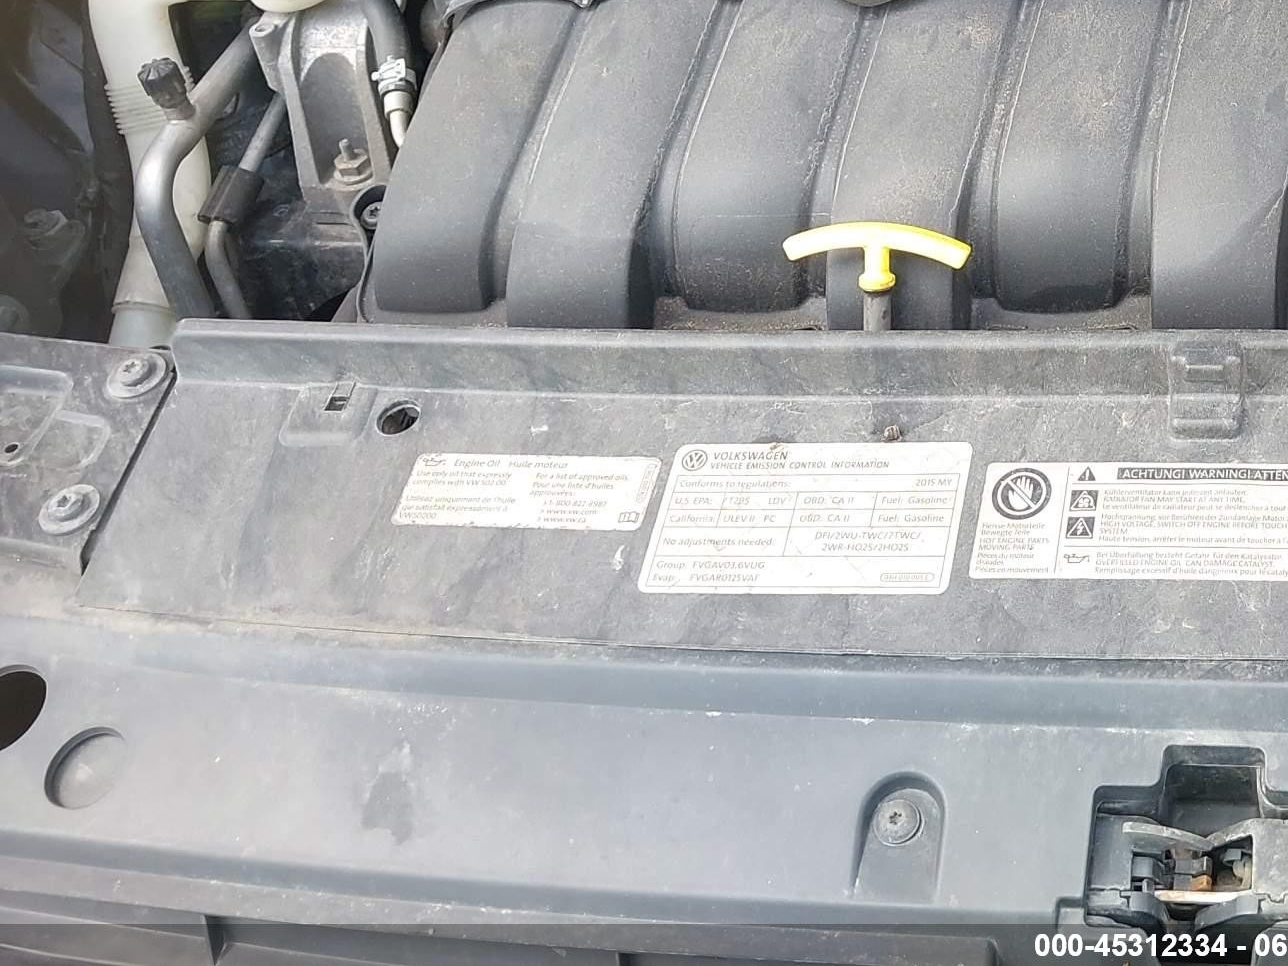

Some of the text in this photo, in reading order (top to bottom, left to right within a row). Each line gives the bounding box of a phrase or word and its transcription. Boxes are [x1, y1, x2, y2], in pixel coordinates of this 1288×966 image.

[713, 451, 789, 461] VOLKSWAGEN
[454, 458, 569, 470] Engine Oil Huile moteur
[710, 460, 890, 470] VEHICLE EMISSION CONTROL INFORMATION
[578, 474, 613, 483] approved
[1121, 468, 1185, 479] ACHTUNG!
[1189, 468, 1251, 480] WARNING!
[680, 480, 722, 488] Conforms
[915, 479, 936, 487] 2015
[908, 496, 948, 505] Gasoline
[904, 514, 945, 522] Gasoline
[663, 537, 676, 545] No
[677, 537, 736, 548] adjustments
